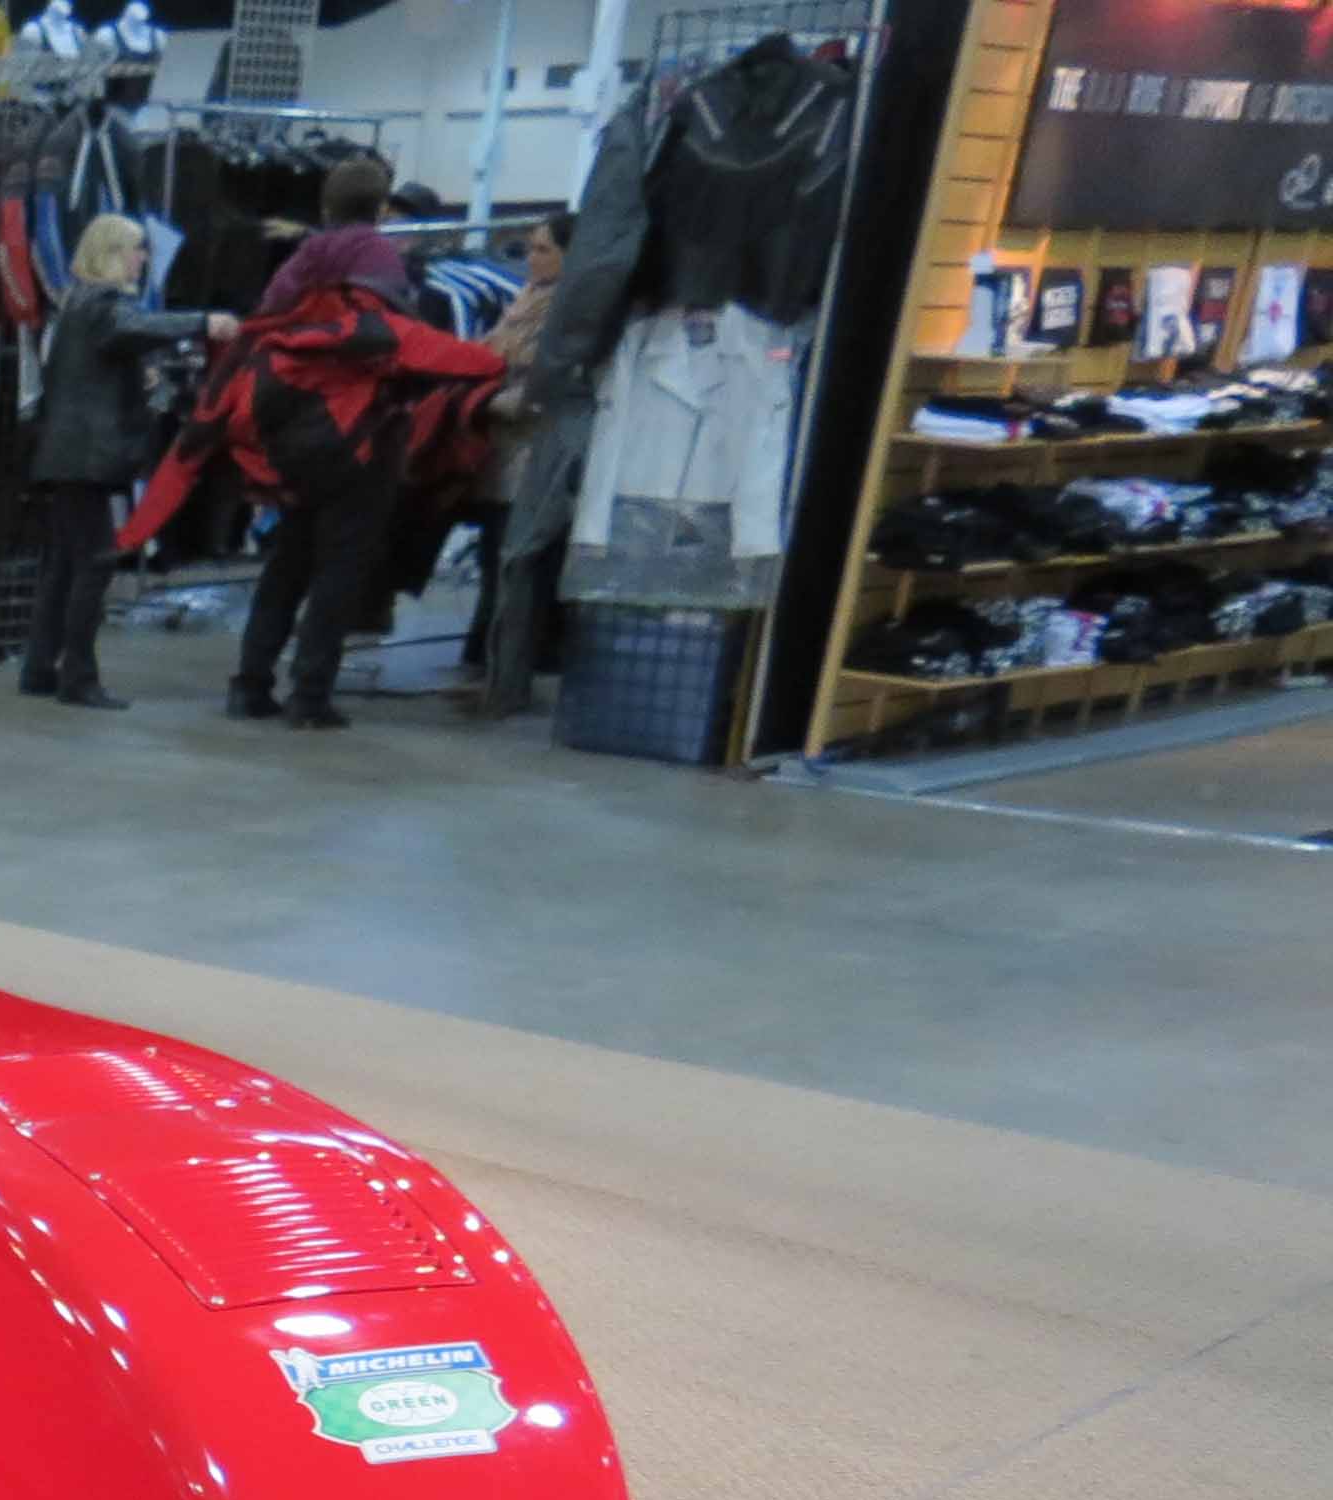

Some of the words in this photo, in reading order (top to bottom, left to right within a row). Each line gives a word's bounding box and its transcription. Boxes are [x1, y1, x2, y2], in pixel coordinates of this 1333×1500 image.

[328, 1350, 476, 1377] MICHELIN
[370, 1394, 450, 1414] GREEN
[373, 1434, 479, 1456] CHALLENGE
